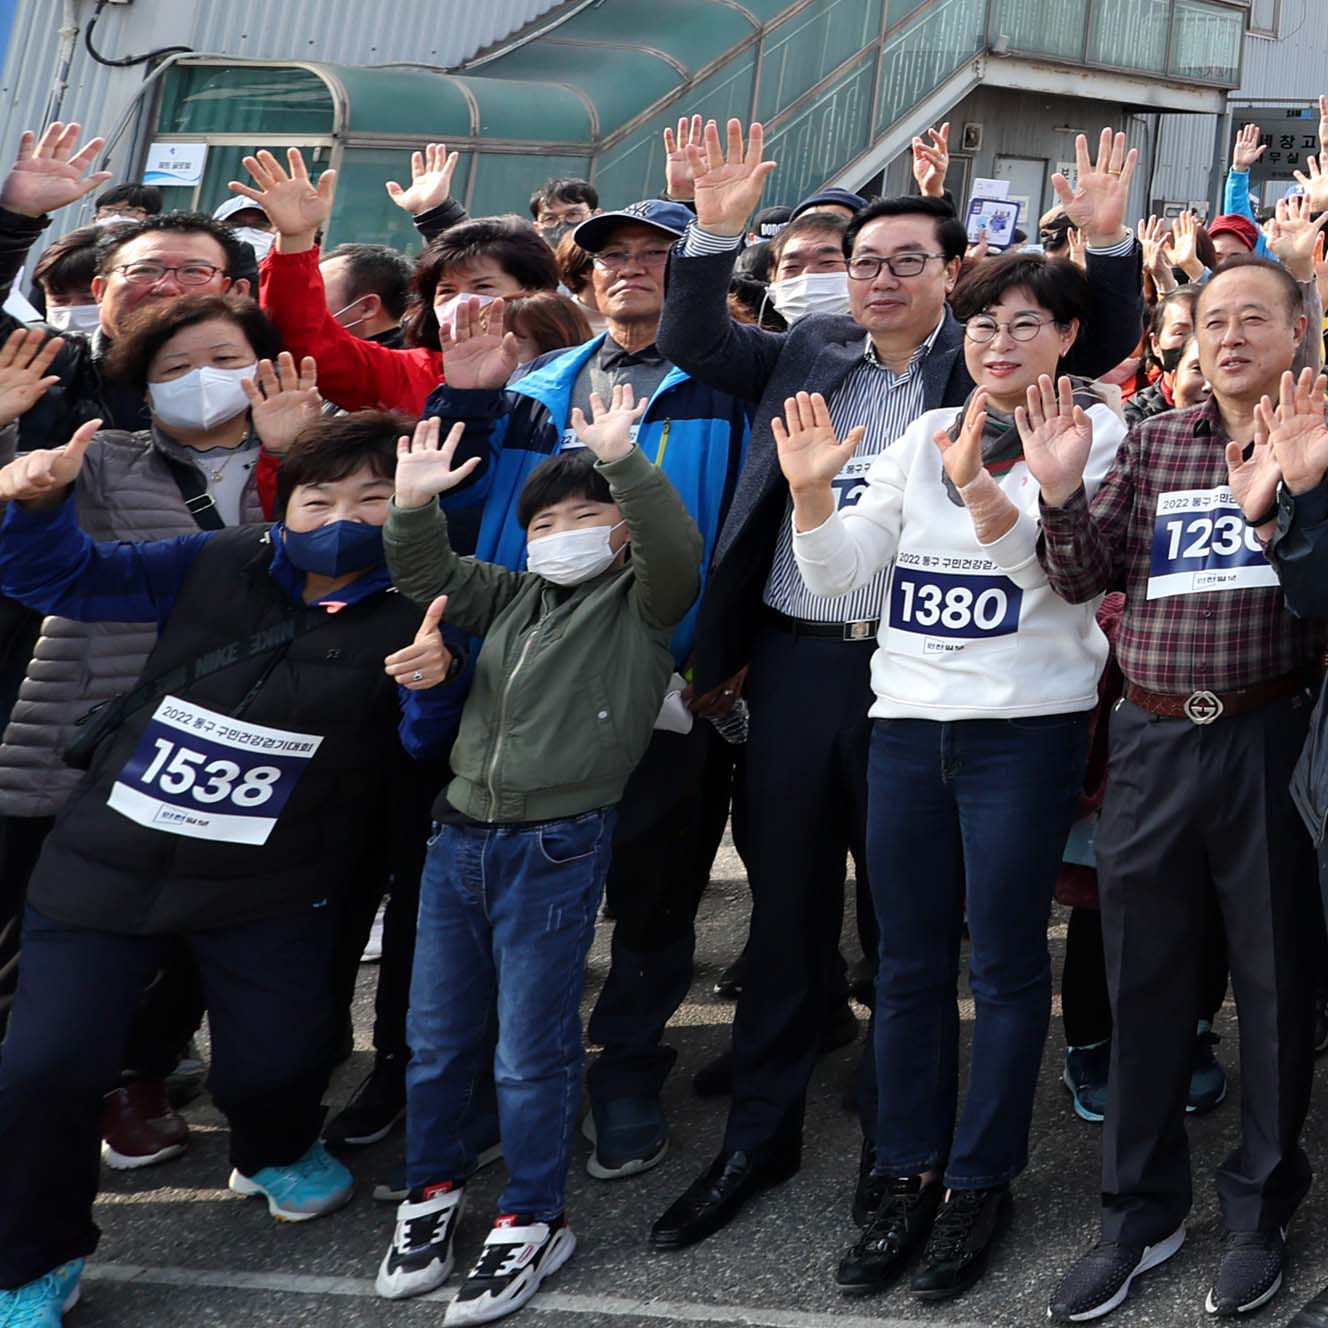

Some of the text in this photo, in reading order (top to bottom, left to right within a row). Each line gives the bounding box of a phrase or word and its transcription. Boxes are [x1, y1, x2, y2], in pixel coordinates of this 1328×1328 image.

[1163, 498, 1189, 510] 2022
[1192, 497, 1212, 508] 동구
[899, 552, 921, 566] 2022
[922, 556, 940, 567] 동구
[900, 581, 1008, 631] 1380
[161, 705, 315, 753] 2022 동구 구민건강걷기대회
[141, 738, 282, 808] 1538
